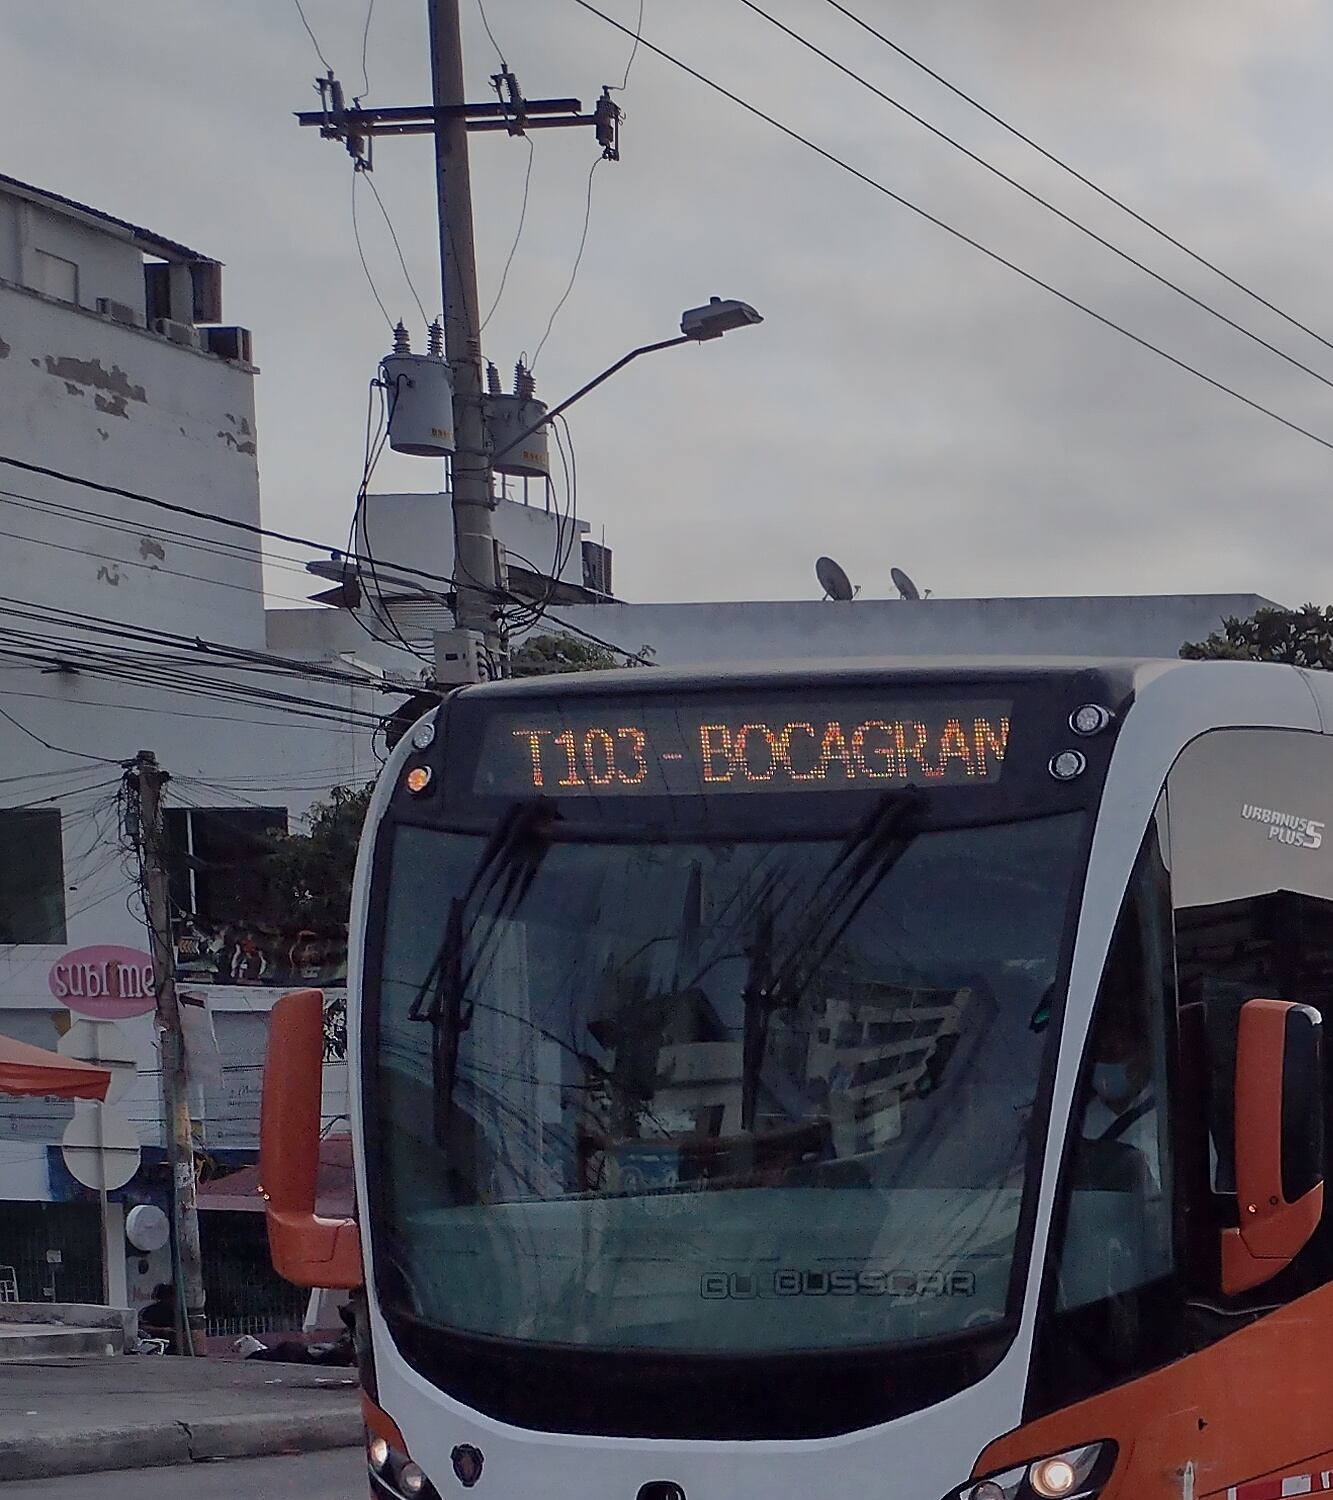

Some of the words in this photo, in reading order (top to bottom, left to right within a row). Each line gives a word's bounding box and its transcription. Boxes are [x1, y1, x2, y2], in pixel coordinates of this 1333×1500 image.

[512, 727, 648, 787] T103
[700, 716, 1010, 783] BOCAGRAN
[1241, 803, 1308, 832] URBANUS
[1268, 825, 1305, 847] PLUS
[773, 1268, 976, 1298] BUSSCAR
